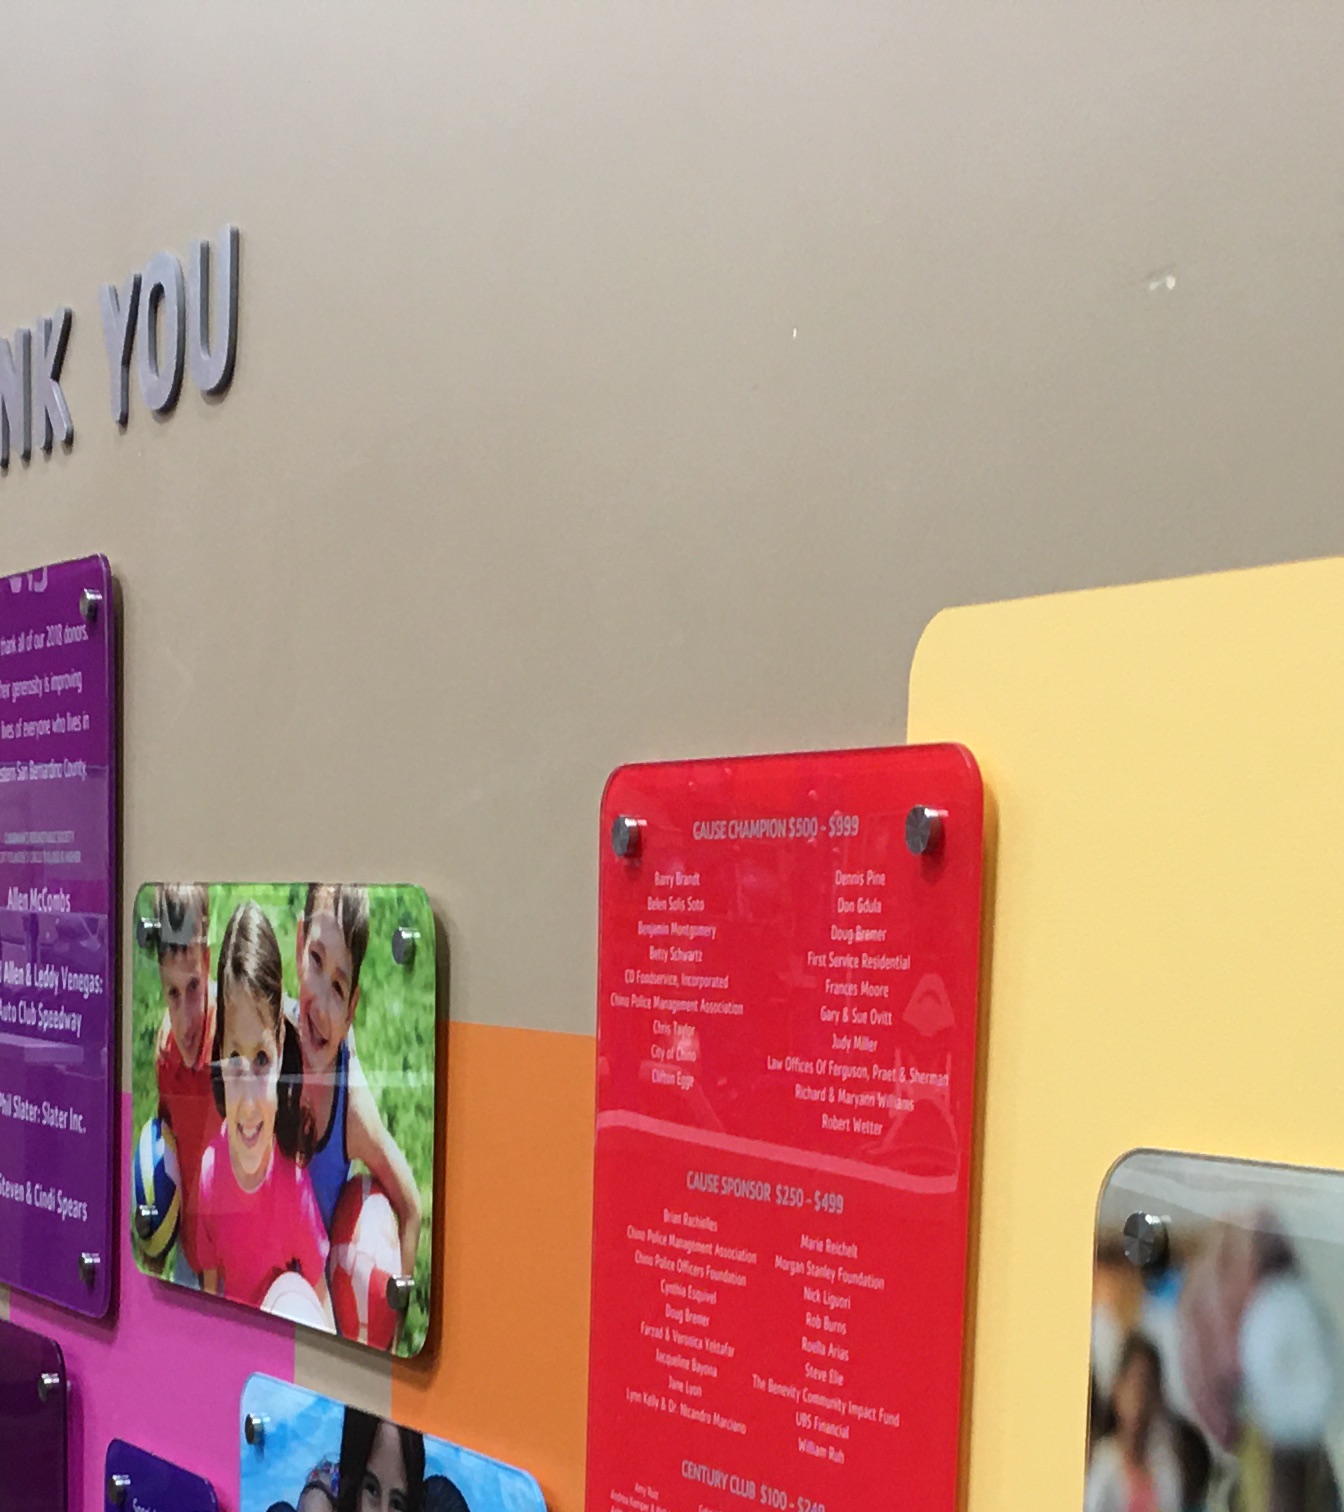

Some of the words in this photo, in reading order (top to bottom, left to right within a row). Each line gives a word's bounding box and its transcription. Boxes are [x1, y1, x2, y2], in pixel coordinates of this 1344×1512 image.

[98, 223, 239, 428] YOU
[692, 820, 727, 840] CAUSE
[728, 818, 787, 839] CHAMPION
[788, 817, 818, 841] $500
[828, 815, 859, 837] $999
[834, 870, 864, 886] Dennis
[866, 870, 885, 886] Pine
[7, 887, 28, 911] Allen
[30, 887, 70, 912] McCombs
[687, 896, 705, 911] Soto
[837, 897, 855, 913] Don
[831, 924, 854, 944] Doug
[670, 946, 703, 962] Schwartz
[807, 951, 827, 967] First
[828, 951, 859, 968] Service
[861, 953, 911, 970] Residential
[4, 961, 24, 984] Allen
[26, 963, 31, 986] &
[61, 966, 103, 999] Venegas:
[681, 973, 729, 989] Incorporated
[825, 979, 858, 996] Frances
[860, 981, 889, 998] Moore
[653, 996, 698, 1014] Management
[700, 998, 744, 1015] Association
[18, 1000, 36, 1025] Club
[38, 1003, 82, 1038] Speedway
[820, 1006, 840, 1023] Gary
[842, 1007, 849, 1022] &
[870, 1008, 892, 1025] Ovitt
[652, 1020, 671, 1035] Chris
[651, 1044, 665, 1060] City
[667, 1048, 674, 1058] of
[832, 1034, 852, 1053] Judy
[853, 1036, 878, 1052] Miller
[767, 1056, 783, 1070] Law
[784, 1056, 814, 1074] Offices
[816, 1058, 827, 1074] Of
[898, 1064, 906, 1083] &
[909, 1067, 950, 1087] Sherman
[795, 1084, 826, 1101] Richard
[828, 1087, 835, 1103] &
[13, 1095, 40, 1123] Slater:
[42, 1101, 68, 1129] Slater
[70, 1108, 86, 1133] Inc.
[822, 1113, 850, 1131] Robert
[26, 1181, 32, 1205] &
[57, 1190, 87, 1222] Spears
[686, 1171, 720, 1194] CAUSE
[721, 1176, 771, 1201] SPONSOR
[776, 1184, 804, 1207] $250
[814, 1190, 844, 1214] $499
[668, 1234, 713, 1255] Management
[714, 1244, 757, 1264] Association
[706, 1265, 747, 1286] Foundation
[774, 1255, 805, 1276] Morgan
[806, 1260, 836, 1283] Stanley
[838, 1267, 885, 1290] Foundation
[803, 1286, 821, 1302] Nick
[665, 1303, 684, 1324] Doug
[806, 1312, 822, 1329] Rob
[805, 1362, 827, 1382] Steve
[660, 1397, 666, 1410] &
[802, 1387, 847, 1415] Community
[848, 1401, 876, 1421] Impact
[878, 1407, 900, 1427] Fund
[681, 1460, 729, 1490] CENTURY
[729, 1475, 756, 1500] CLUB
[760, 1484, 788, 1511] $100
